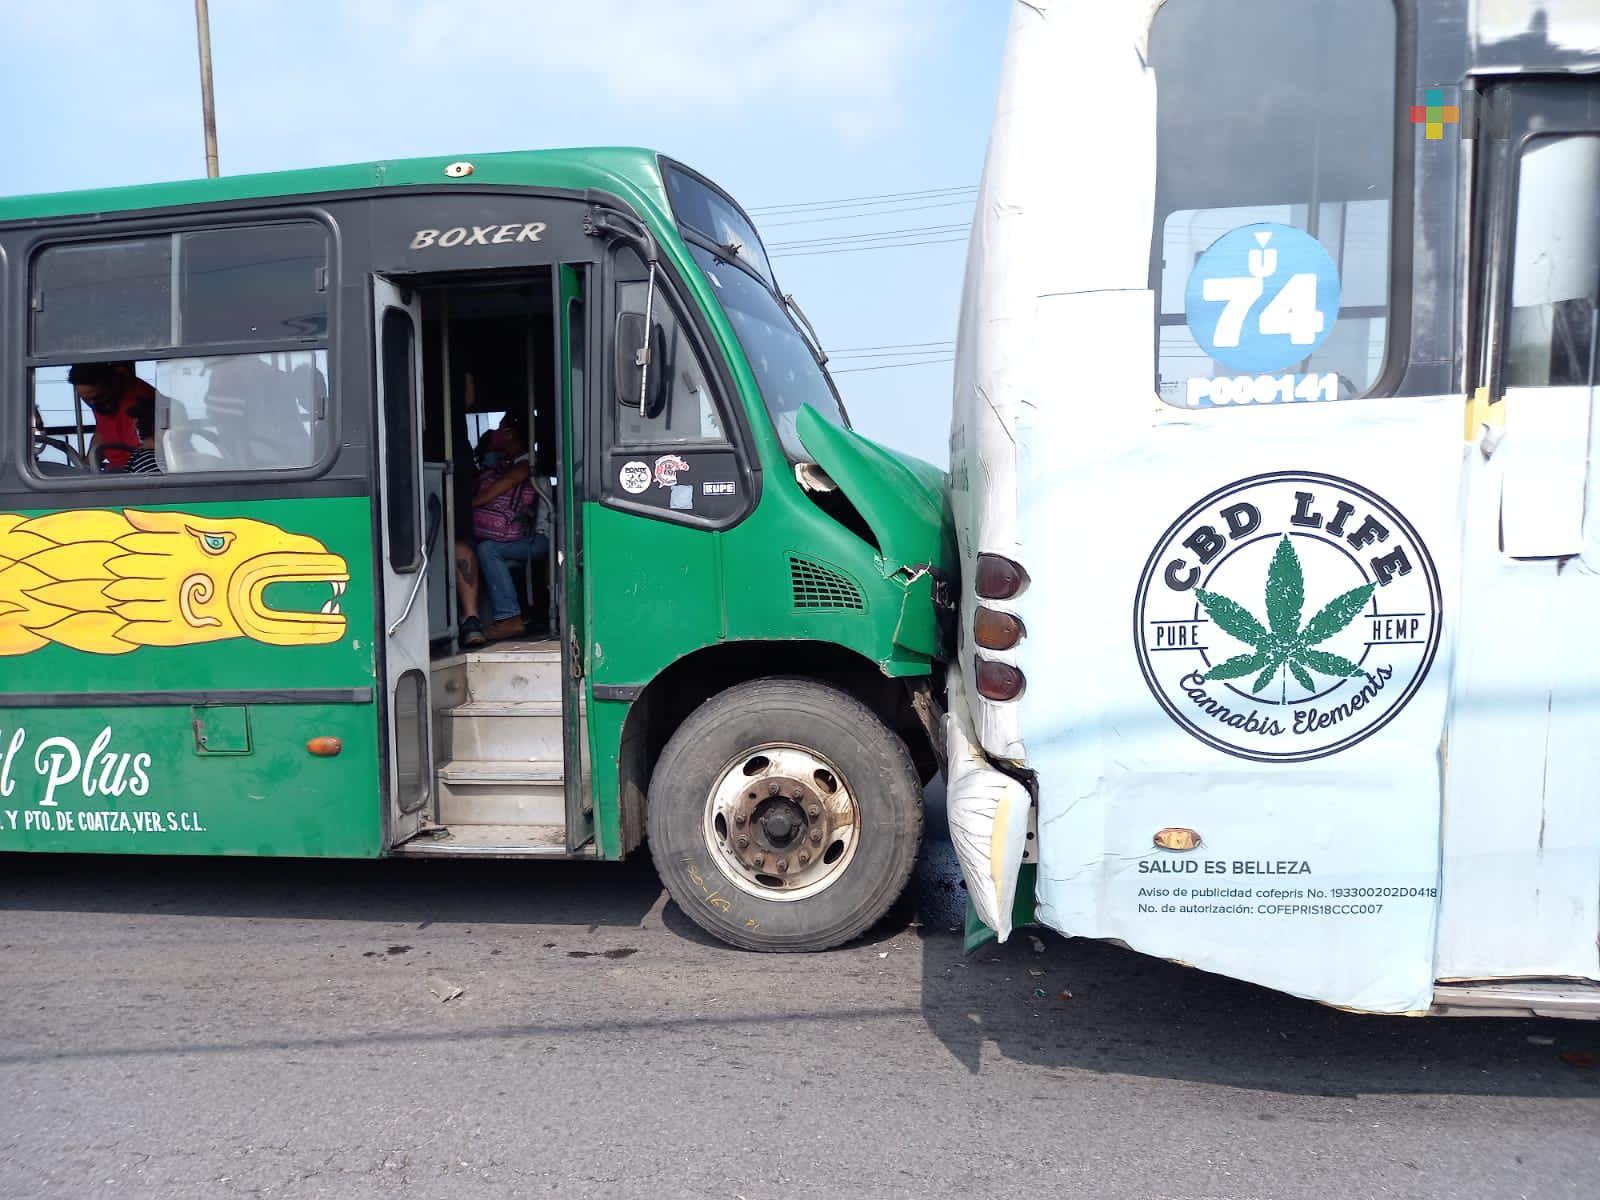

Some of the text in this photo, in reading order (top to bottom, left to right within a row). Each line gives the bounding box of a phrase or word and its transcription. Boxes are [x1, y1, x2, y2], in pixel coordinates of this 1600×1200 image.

[409, 222, 547, 250] BOXER
[1248, 248, 1278, 277] U
[1203, 273, 1324, 347] 74
[1186, 373, 1339, 405] P000141
[1164, 491, 1412, 592] CBD LIFE
[1156, 625, 1200, 647] PURE
[1372, 618, 1420, 641] HEMP
[1179, 664, 1393, 736] Cannabis Elements
[34, 726, 152, 807] Plus
[5, 810, 18, 830] Y
[1138, 860, 1312, 875] SALUD ES BELLEZA
[1138, 887, 1438, 900] Aviso de publicidad cofepris No. 193300202D0418
[1138, 903, 1383, 915] No. de autorización: COFEPRIS18CCC007
